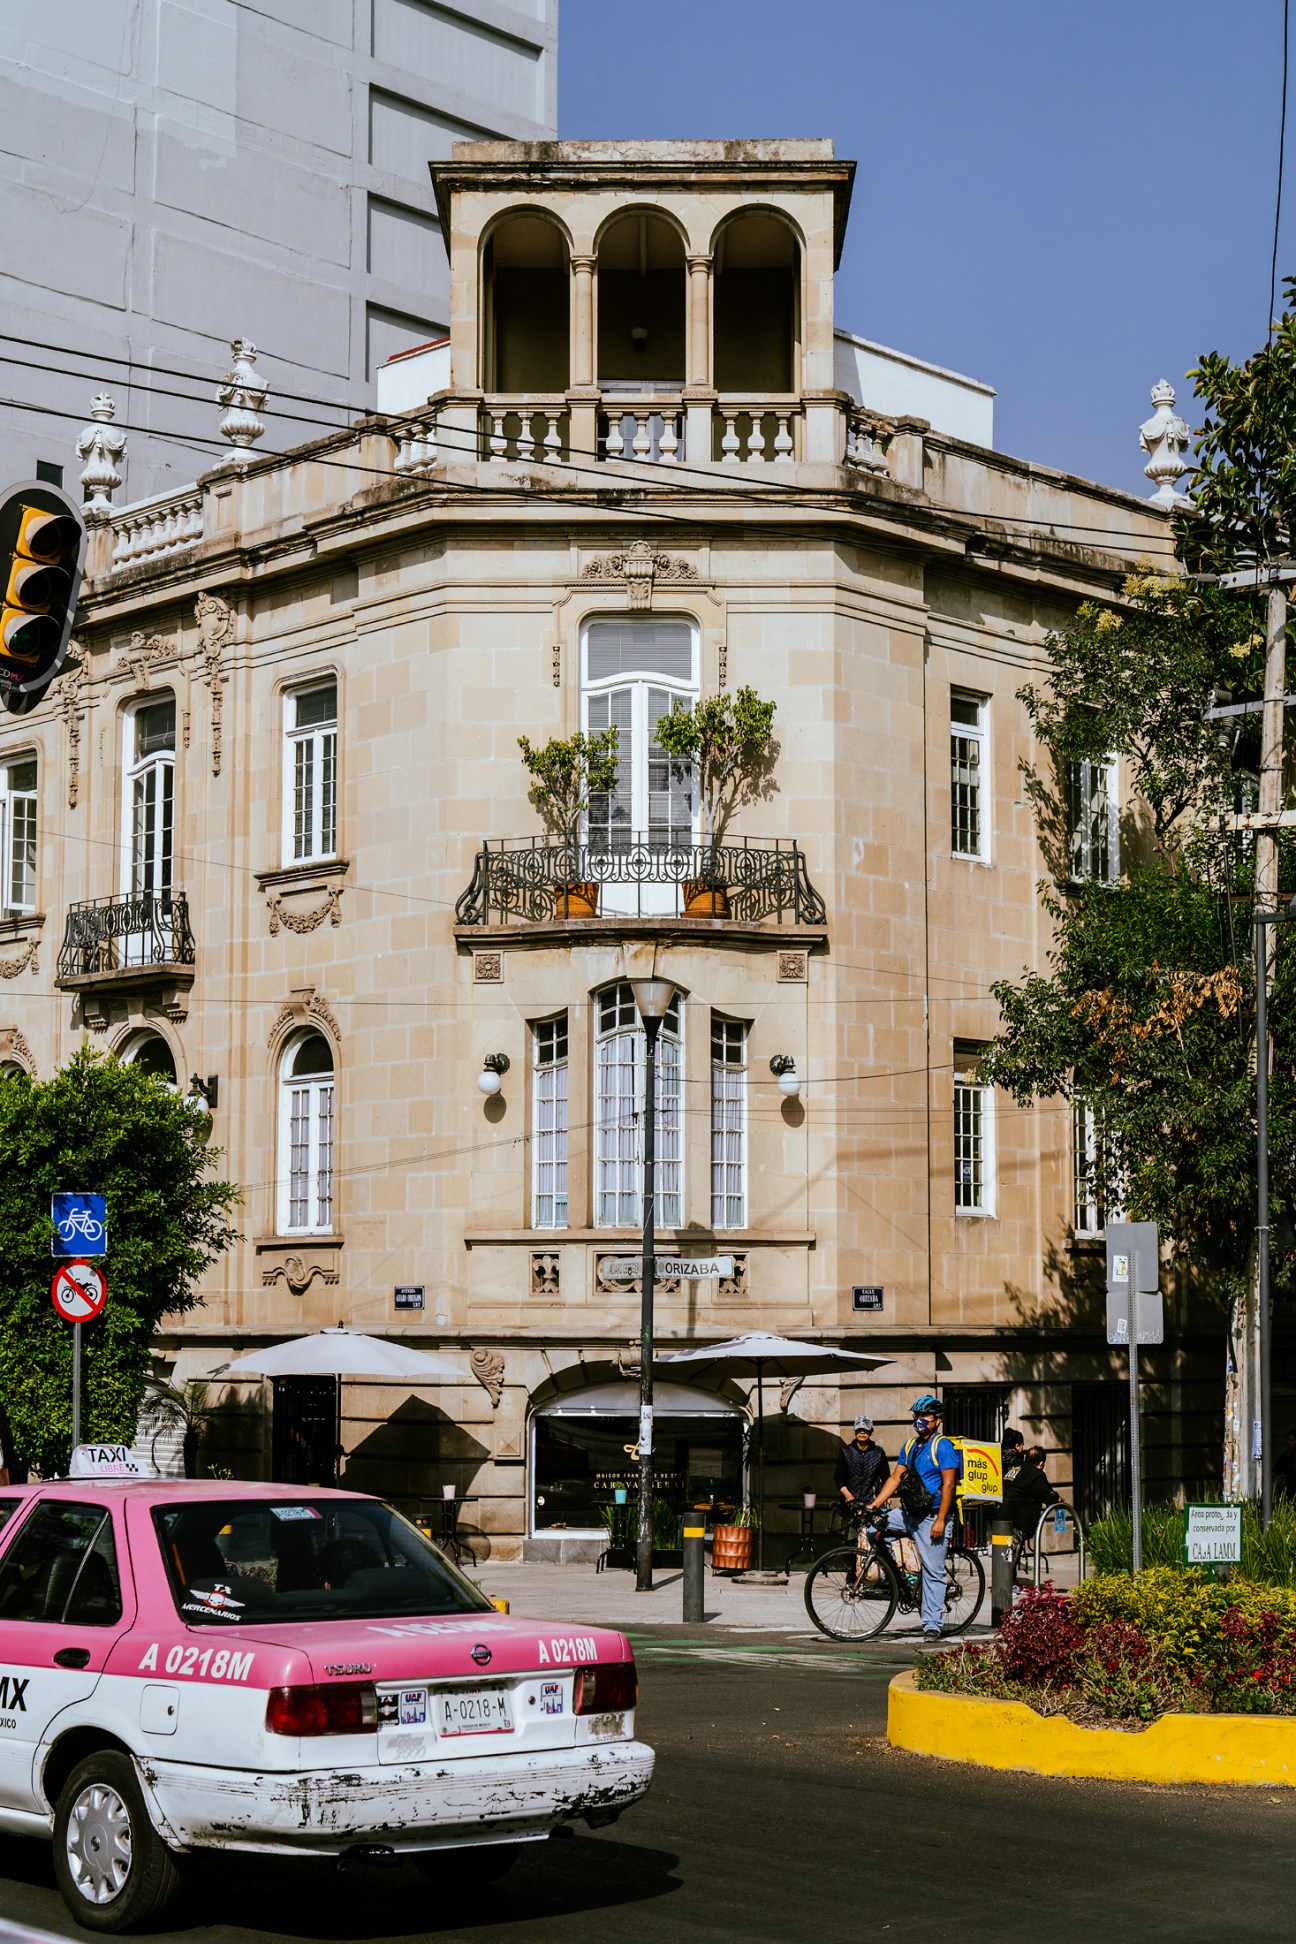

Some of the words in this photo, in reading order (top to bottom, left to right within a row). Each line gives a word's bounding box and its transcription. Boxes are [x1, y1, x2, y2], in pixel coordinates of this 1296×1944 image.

[665, 1262, 720, 1274] ORIZABA
[88, 1447, 126, 1463] TAXI
[100, 1464, 124, 1473] LIBRE
[967, 1458, 987, 1469] más
[968, 1470, 987, 1482] glup
[982, 1482, 998, 1494] glup
[1205, 1511, 1233, 1520] proteda
[1234, 1511, 1238, 1520] y
[1193, 1524, 1225, 1533] conservada
[1226, 1525, 1236, 1534] por
[1213, 1543, 1236, 1559] LAMM
[214, 1583, 232, 1594] TX
[181, 1603, 241, 1621] MERCENARIOS
[538, 1639, 550, 1663] A
[551, 1637, 598, 1663] 0218M
[138, 1643, 159, 1671] A
[165, 1644, 256, 1681] 0218M
[324, 1663, 372, 1676] TSURU
[405, 1692, 422, 1703] UAF
[444, 1697, 507, 1721] A-0218-M
